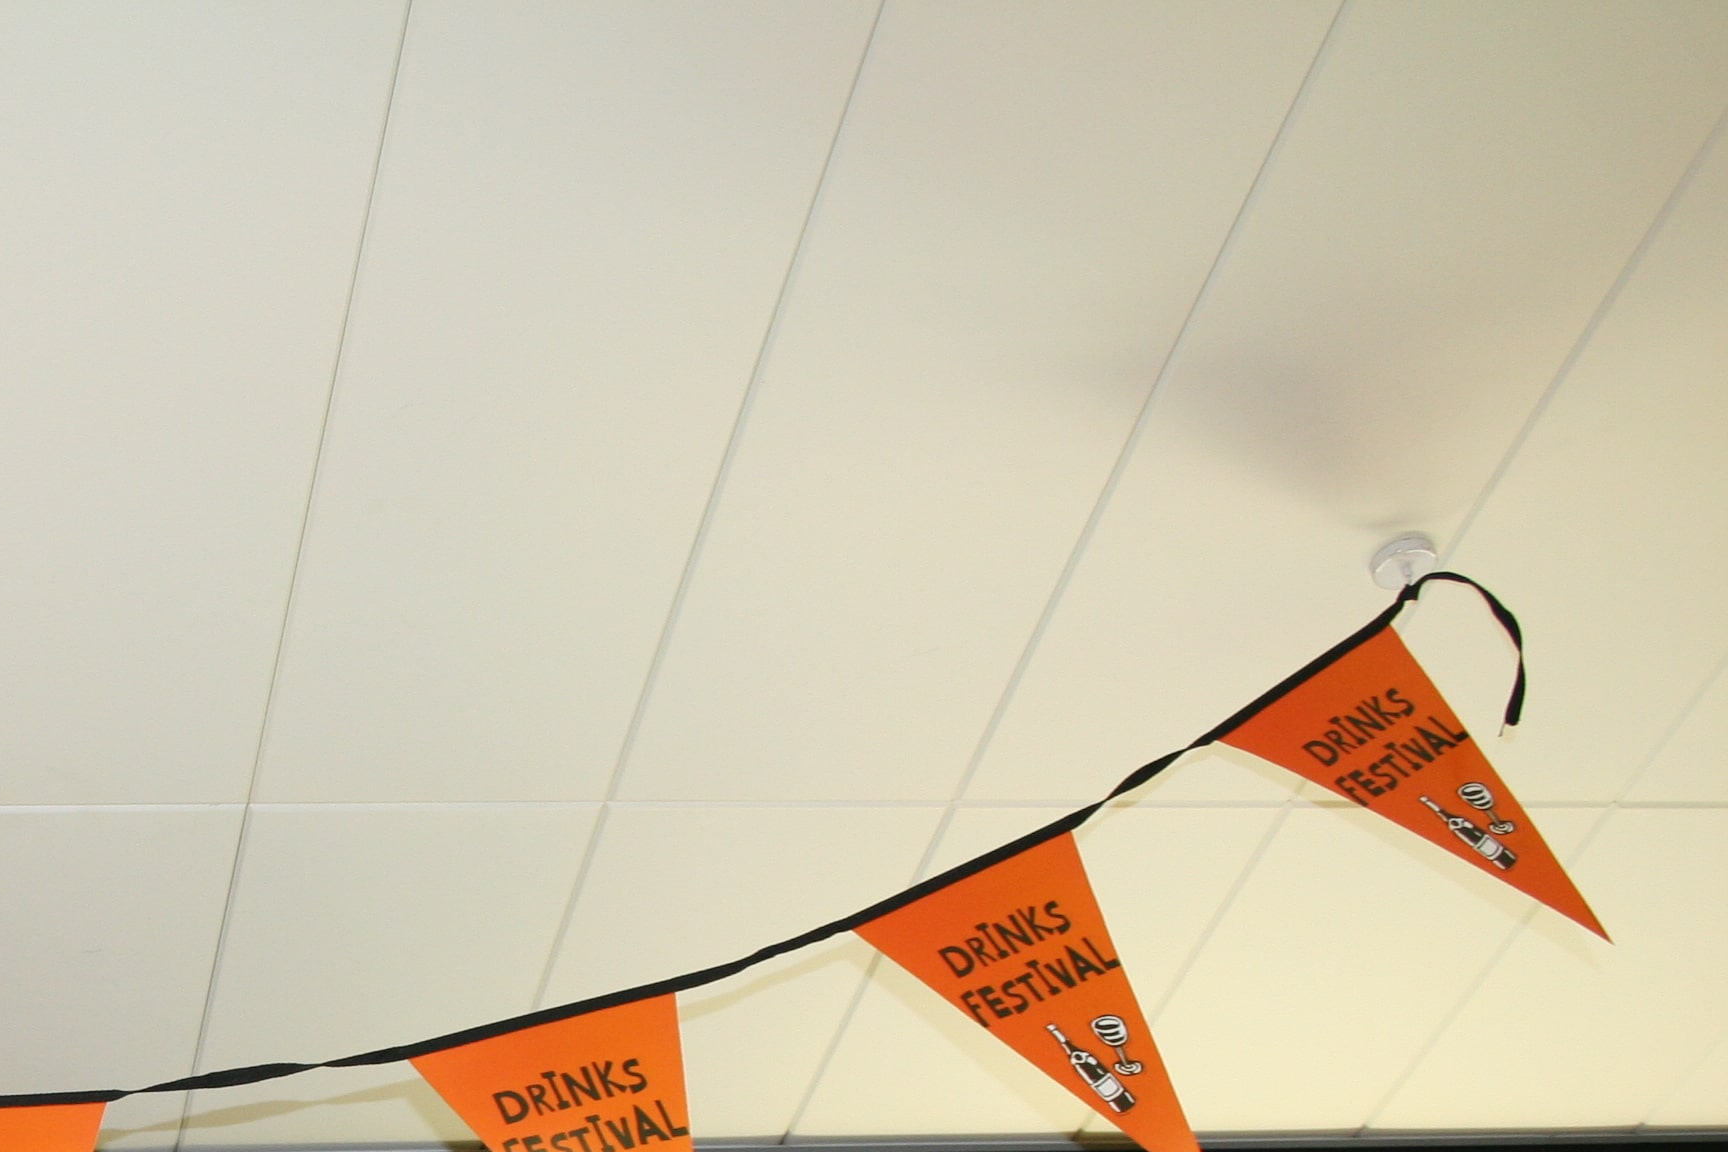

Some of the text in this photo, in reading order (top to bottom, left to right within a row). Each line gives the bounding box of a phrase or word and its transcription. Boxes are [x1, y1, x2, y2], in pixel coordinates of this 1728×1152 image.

[1302, 688, 1416, 768] DRINKS
[1334, 716, 1471, 808] FESTIVAL
[938, 900, 1072, 979] DRINKS
[960, 937, 1122, 1029] FESTIVAL
[492, 1058, 648, 1125] DRINKS
